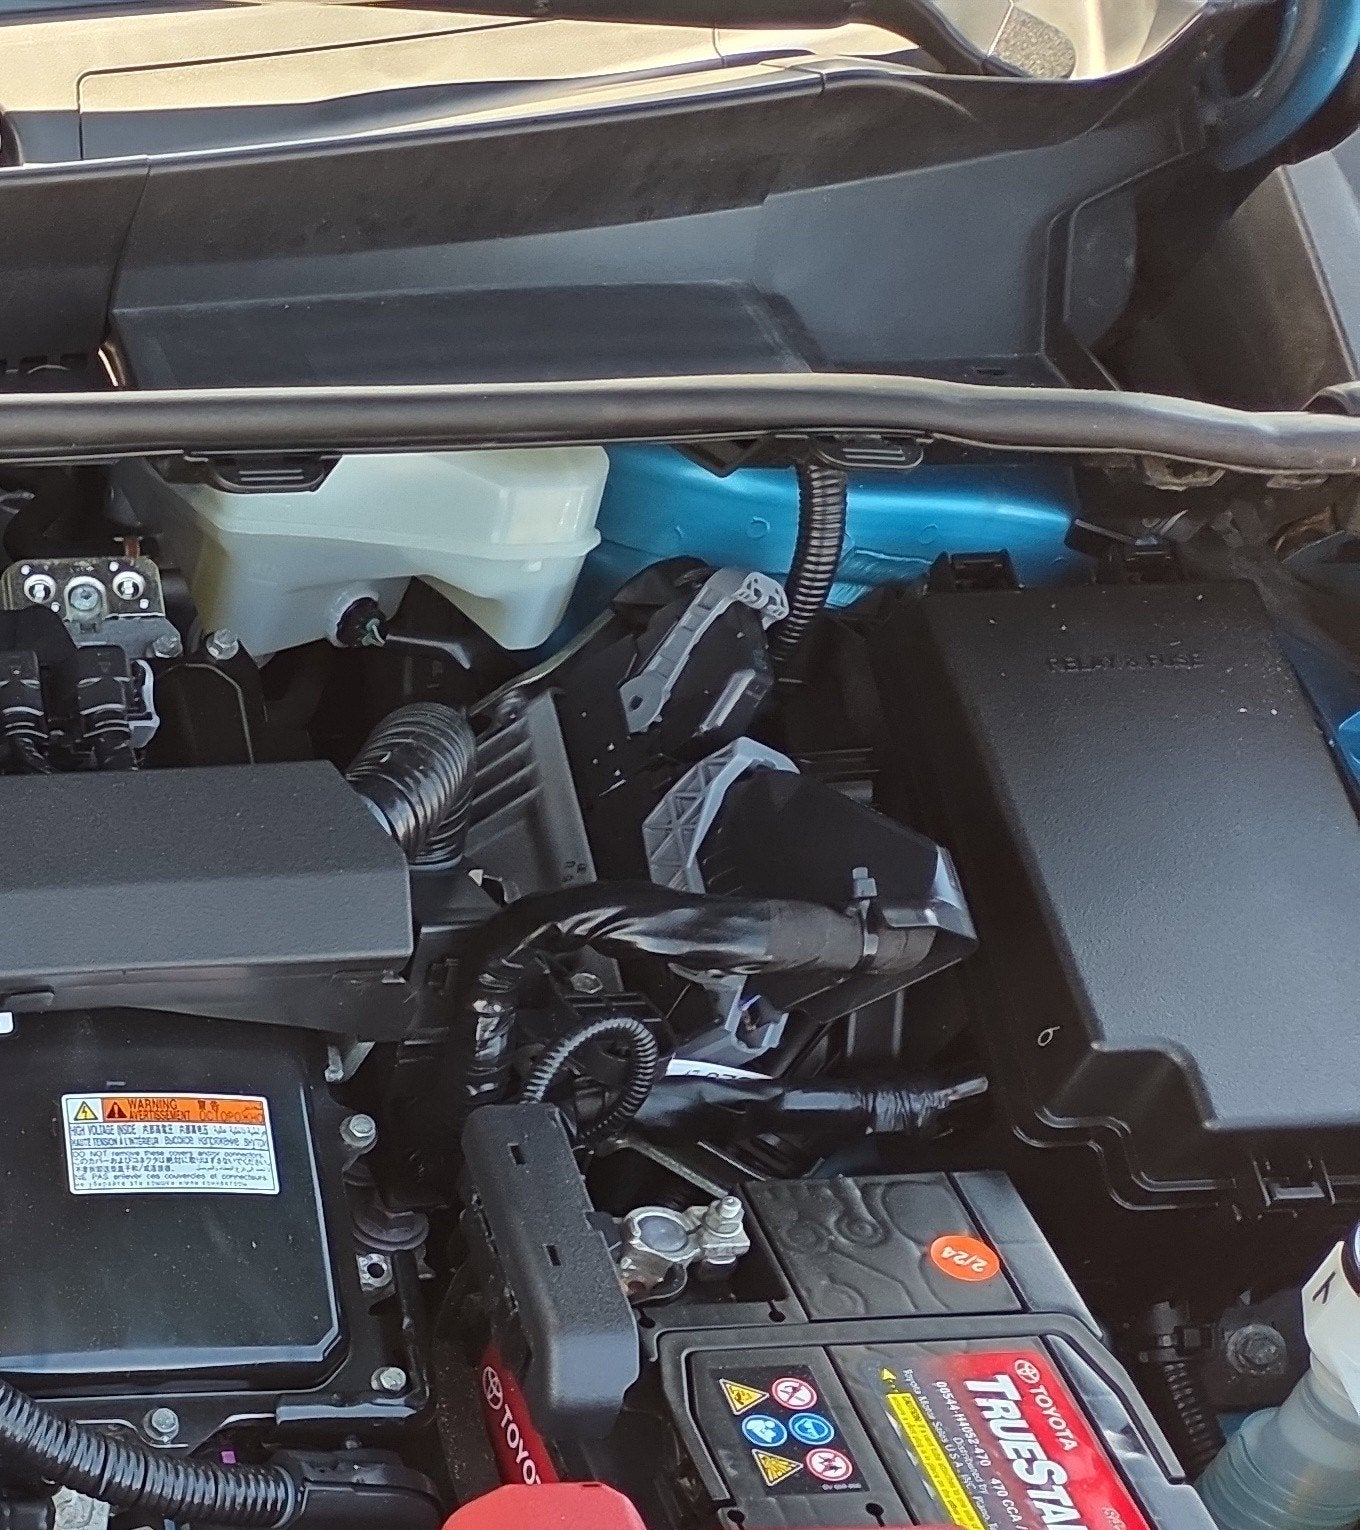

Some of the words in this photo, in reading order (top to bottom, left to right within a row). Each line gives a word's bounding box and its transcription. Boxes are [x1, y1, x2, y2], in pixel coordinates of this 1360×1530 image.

[127, 1099, 177, 1109] WARNING
[128, 1110, 190, 1120] AVERTISSEMENT
[941, 1246, 988, 1272] 2/24
[1028, 1385, 1078, 1451] TOYOTA
[501, 1404, 542, 1484] TOYO
[990, 1478, 1009, 1497] 470
[1002, 1500, 1023, 1522] CCA
